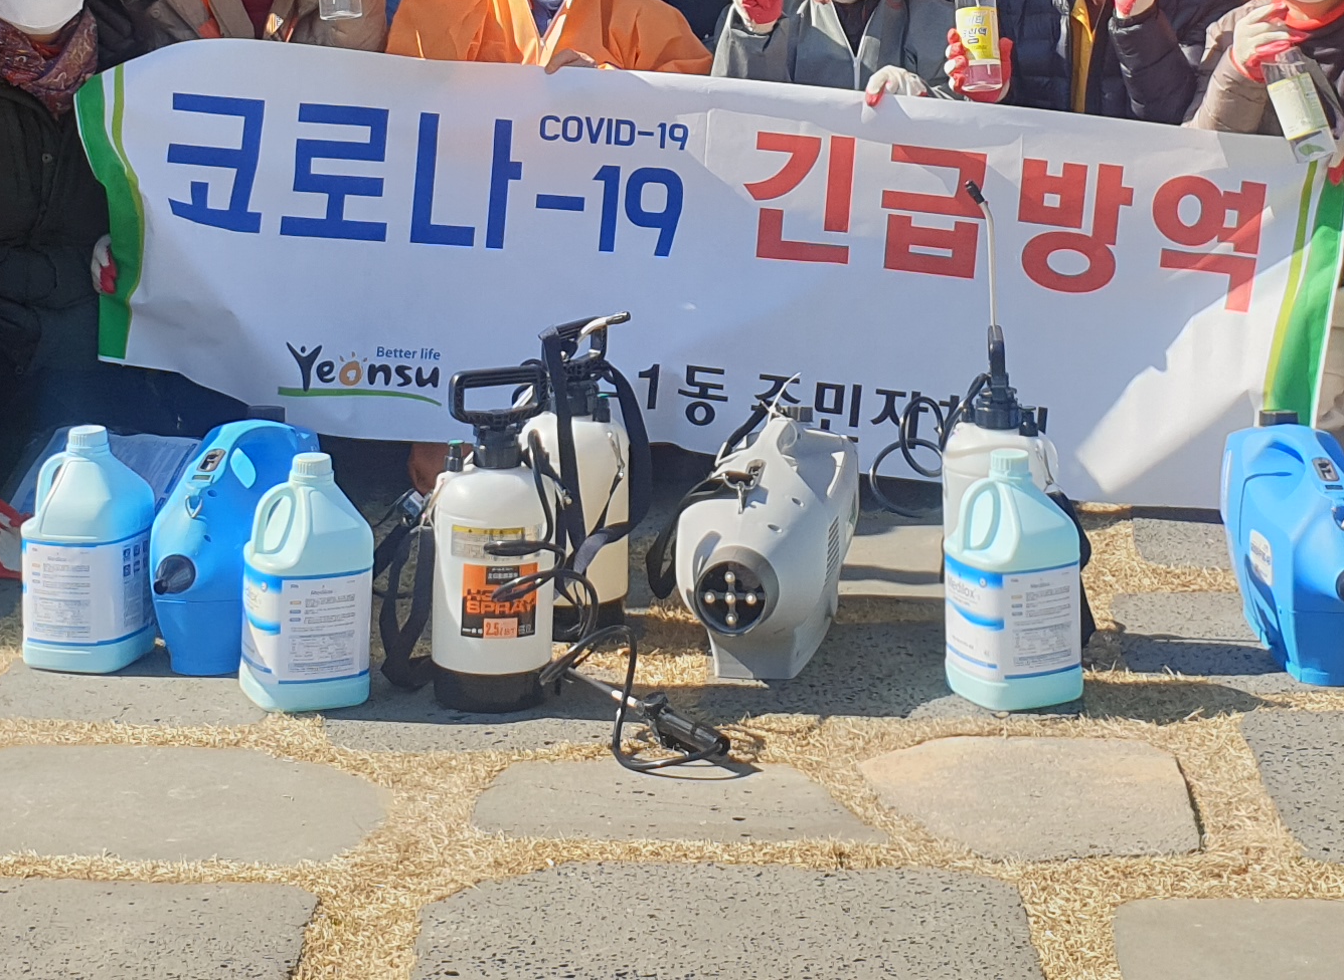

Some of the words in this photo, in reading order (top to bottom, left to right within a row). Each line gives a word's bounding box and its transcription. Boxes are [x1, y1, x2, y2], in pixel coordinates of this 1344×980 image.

[538, 114, 689, 151] COVID-19
[167, 92, 684, 257] 코로나-19
[744, 131, 1267, 313] 긴급방역
[285, 340, 440, 393] Yeonsu
[375, 346, 418, 360] Better
[420, 347, 441, 361] life
